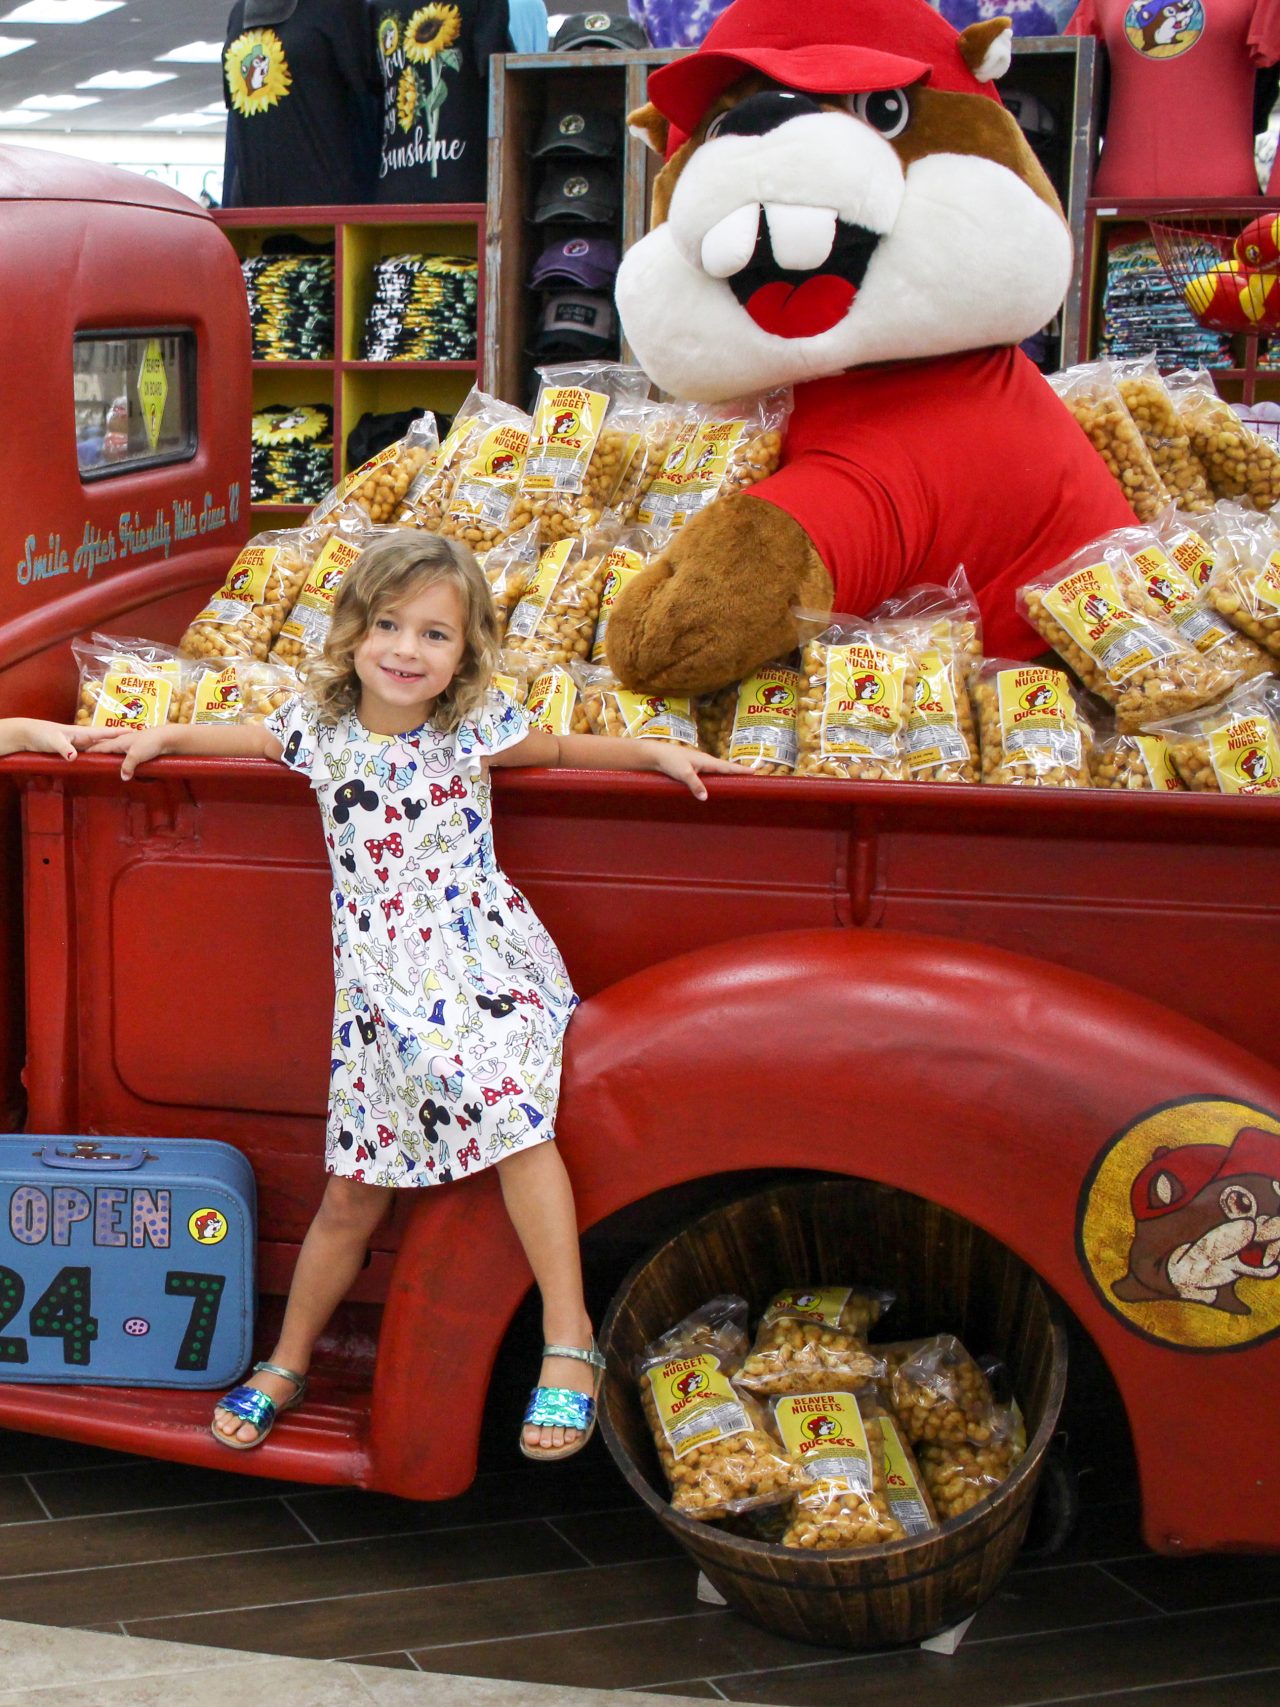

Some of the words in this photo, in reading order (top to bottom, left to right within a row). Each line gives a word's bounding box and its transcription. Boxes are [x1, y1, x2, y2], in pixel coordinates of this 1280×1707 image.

[379, 126, 467, 178] Sunshine
[557, 389, 591, 401] BEAVER
[493, 435, 528, 455] NUGGET
[17, 533, 71, 585] Smile
[73, 520, 117, 579] After
[120, 511, 172, 559] Friendly
[173, 499, 197, 541] Mile
[199, 491, 227, 535] Since
[329, 552, 353, 568] NUGG
[337, 544, 360, 561] BEAVE
[1140, 560, 1161, 577] GETS
[1058, 570, 1095, 596] BEAVER
[1015, 675, 1061, 688] NUGGETS
[1018, 669, 1059, 678] BEAVER
[121, 677, 155, 688] BEAVER
[9, 1185, 171, 1248] OPEN
[794, 1396, 835, 1405] BEAVER
[791, 1404, 842, 1414] NUGGETS
